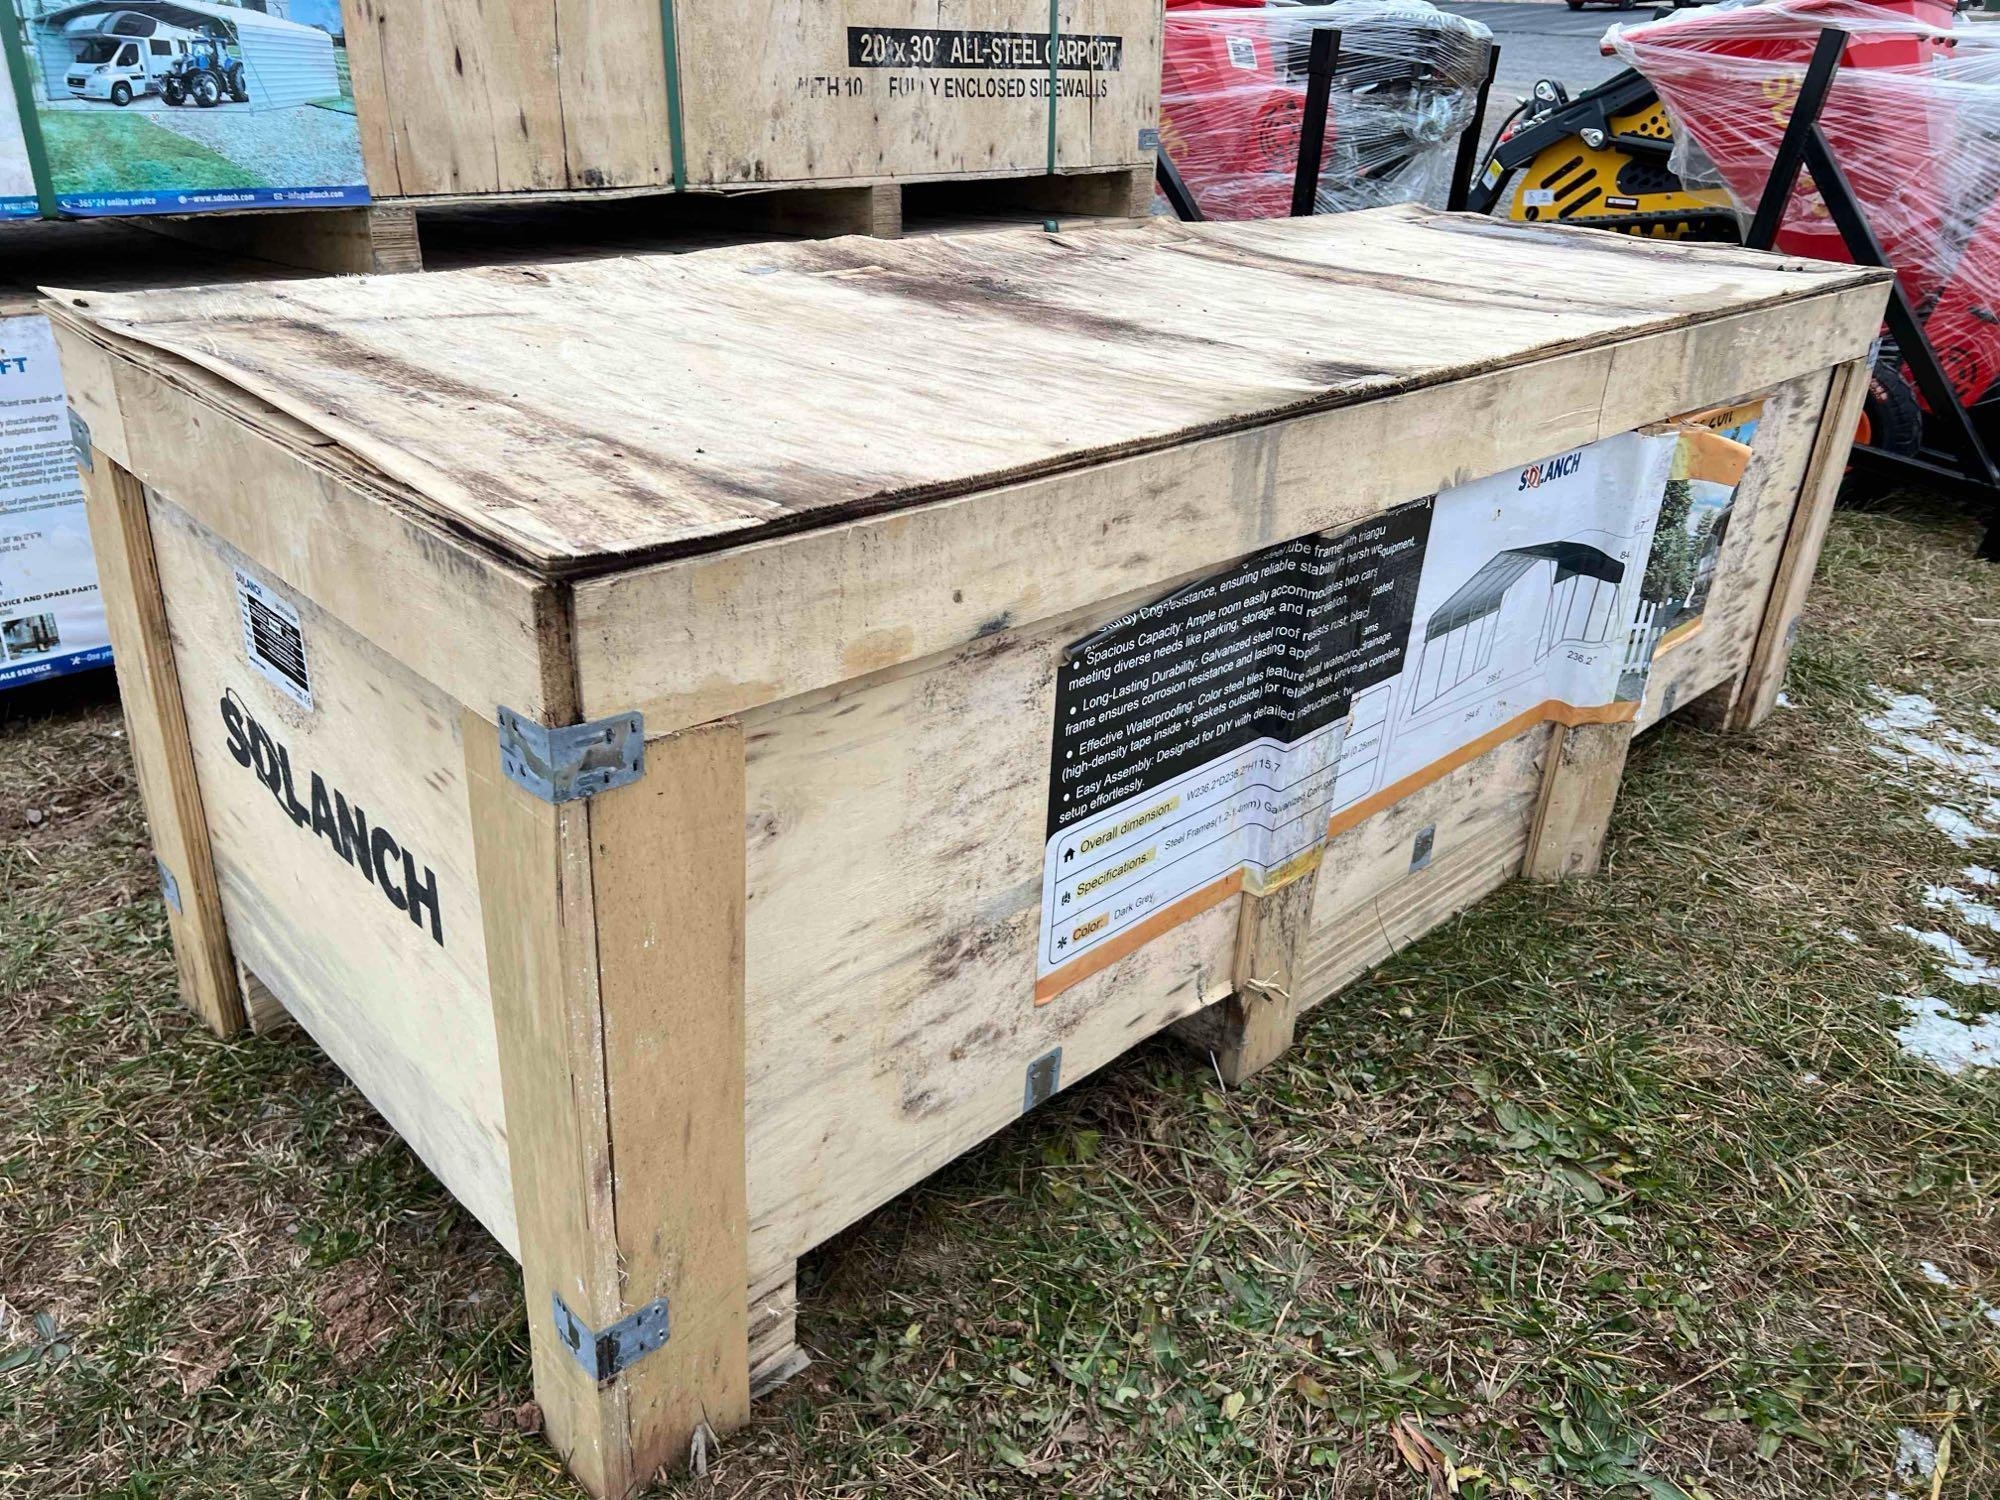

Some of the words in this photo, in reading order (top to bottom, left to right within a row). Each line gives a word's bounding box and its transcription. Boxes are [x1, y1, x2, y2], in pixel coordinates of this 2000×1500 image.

[950, 37, 1042, 65] ALL-STEEL
[944, 77, 1025, 99] ENCLOSED
[1029, 77, 1107, 99] SIDEWALLS
[1220, 569, 1259, 592] ensuring
[1260, 558, 1296, 578] reliable
[1346, 546, 1369, 564] harsh
[1314, 543, 1343, 558] frame
[23, 593, 42, 603] AND
[44, 588, 69, 600] SPARE
[72, 584, 98, 594] PARTS
[1068, 667, 1111, 691] meeting
[1114, 652, 1151, 674] diverse
[1153, 639, 1184, 660] needs
[1185, 633, 1202, 648] like
[1203, 619, 1239, 643] parking,
[1242, 605, 1277, 626] storage,
[1279, 602, 1304, 616] and
[1087, 640, 1135, 666] Spacious
[1138, 622, 1184, 647] Capacity:
[1186, 610, 1216, 630] Ample
[1218, 600, 1241, 618] room
[1243, 589, 1270, 609] easily
[17, 663, 52, 677] SERVICE
[1082, 677, 1149, 711] Long-Lasting
[1152, 660, 1198, 685] Durability:
[1200, 635, 1251, 665] Galvanized
[1252, 627, 1274, 645] steel
[1275, 626, 1301, 640] roof
[1302, 623, 1330, 641] resists
[1369, 647, 1401, 668] complete
[1065, 716, 1099, 737] frame
[1099, 703, 1139, 724] ensures
[1141, 681, 1186, 706] corrosion
[1187, 661, 1234, 688] resistance
[1235, 651, 1253, 668] and
[1254, 644, 1286, 661] lasting
[1079, 729, 1124, 756] Effective
[1126, 699, 1195, 736] Waterproofing:
[1198, 688, 1222, 706] Color
[1223, 676, 1246, 695] steel
[1246, 671, 1264, 686] tiles
[1266, 666, 1305, 683] feature
[1061, 745, 1128, 783] (high-density
[1130, 735, 1152, 752] tape
[1153, 721, 1182, 742] inside
[1191, 702, 1227, 727] gaskets
[1228, 685, 1263, 709] outside)
[1264, 682, 1280, 694] for
[1316, 672, 1334, 689] leak
[1076, 780, 1102, 800] Easy
[1103, 756, 1155, 787] Assembly:
[1156, 734, 1200, 763] Designed
[1201, 729, 1215, 743] for
[1216, 719, 1234, 737] DIY
[1234, 711, 1252, 728] with
[1253, 704, 1296, 722] detailed
[1059, 804, 1088, 824] setup
[1090, 778, 1145, 810] effortlessly.
[1081, 826, 1118, 855] Overall
[1120, 801, 1174, 836] dimension:
[1076, 852, 1150, 896] Specifications:
[1164, 832, 1185, 850] Steel
[1072, 916, 1105, 942] Color:
[1113, 902, 1134, 920] Dark
[1135, 891, 1156, 909] Grey
